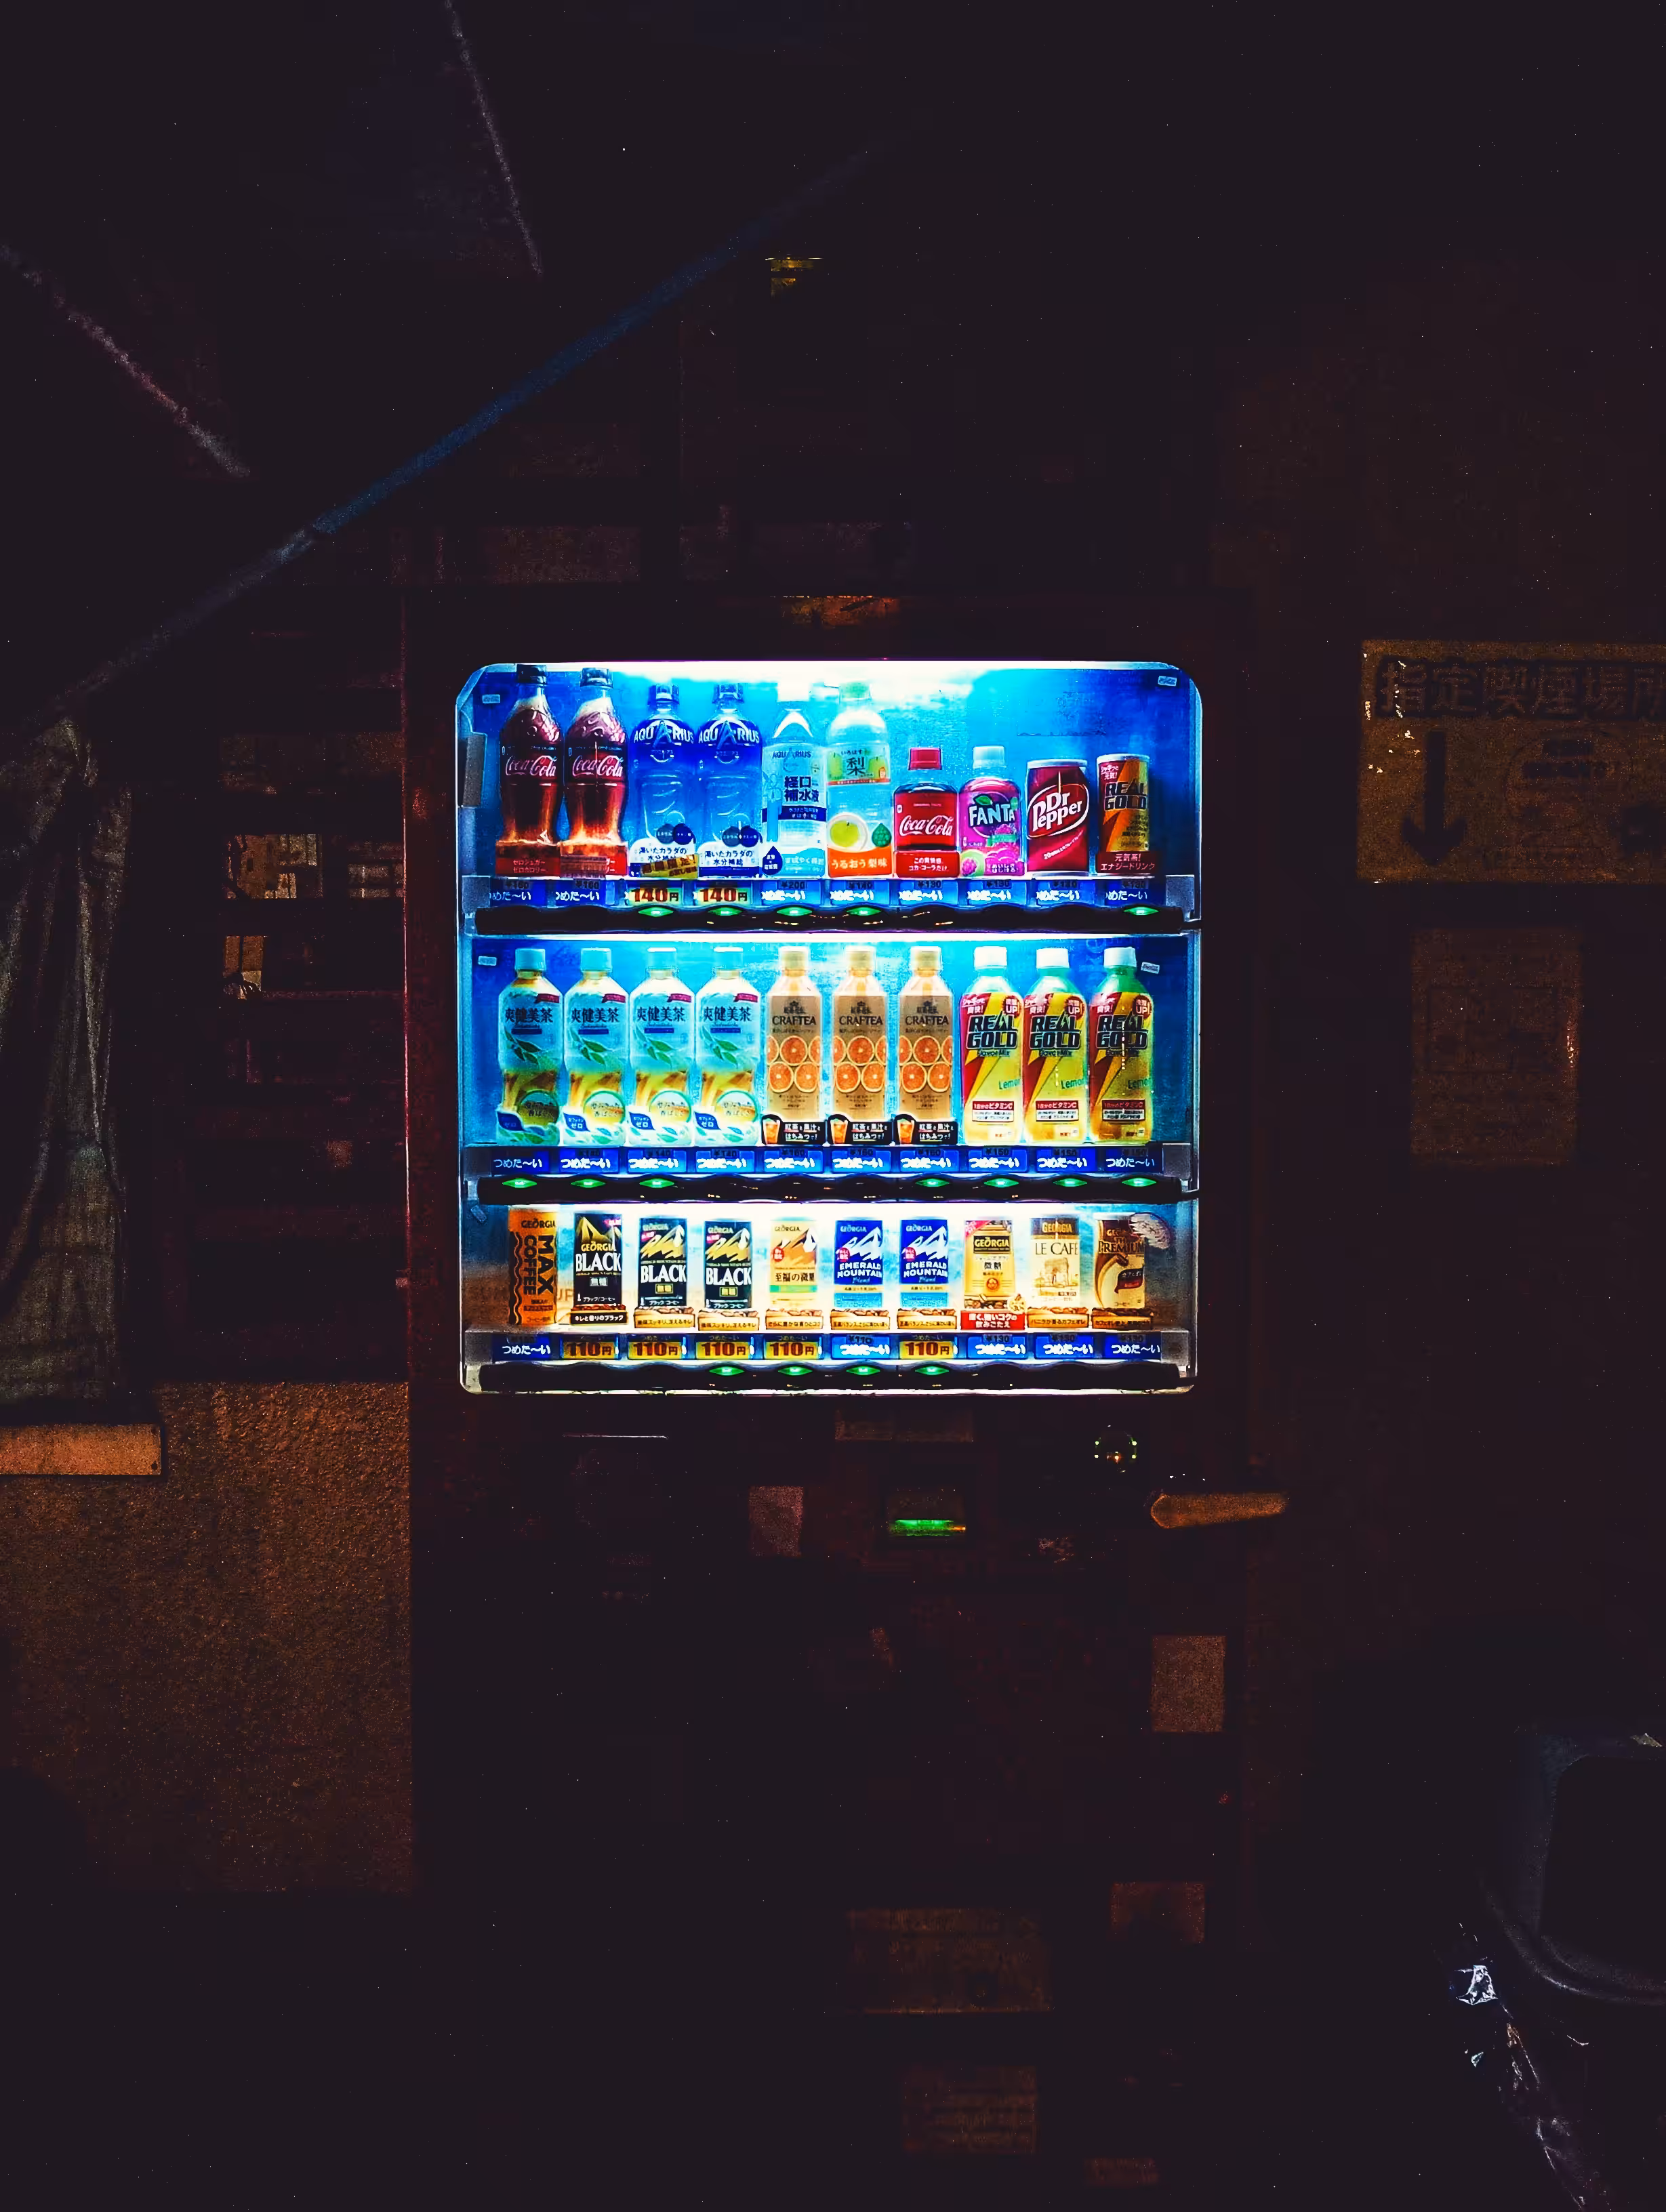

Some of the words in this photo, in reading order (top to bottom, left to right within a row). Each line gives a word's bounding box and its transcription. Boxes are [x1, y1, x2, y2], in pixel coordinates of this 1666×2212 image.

[634, 722, 694, 747] AQUARIUS
[698, 722, 760, 748] AQUARIUS
[506, 756, 557, 777] Coca-Cola
[573, 756, 624, 777] Coca-Cola
[847, 756, 867, 776] 梨
[784, 776, 811, 788] 経口
[1105, 782, 1147, 797] REAL
[1047, 792, 1070, 810] Dr
[1104, 796, 1147, 811] GOLD
[969, 804, 1015, 827] FANTA
[1032, 800, 1082, 832] Pepper
[899, 815, 954, 836] Coca-Cola
[631, 888, 679, 902] 140円
[699, 888, 748, 902] 140円
[505, 1007, 553, 1023] 爽健美茶
[571, 1007, 619, 1023] 爽健美茶
[637, 1006, 686, 1022] 爽健美茶
[704, 1006, 752, 1022] 爽健美茶
[772, 1016, 817, 1025] CRAFTEA
[839, 1016, 884, 1025] CRAFTEA
[905, 1016, 950, 1025] CRAFTEA
[969, 1014, 1019, 1032] REAL
[1031, 1014, 1081, 1032] REAL
[1097, 1014, 1148, 1032] REAL
[966, 1031, 1018, 1050] GOLD
[1029, 1031, 1081, 1050] GOLD
[1095, 1031, 1147, 1050] GOLD
[974, 1237, 1011, 1248] GEORGIA
[1035, 1242, 1047, 1255] LE
[523, 1235, 537, 1296] COFFEE
[537, 1235, 554, 1296] MAX
[575, 1252, 622, 1272] BLACK
[839, 1262, 882, 1271] EMERALD
[906, 1261, 948, 1270] EMERALD
[641, 1265, 687, 1283] BLACK
[706, 1267, 752, 1286] BLACK
[567, 1343, 612, 1357] 110円
[633, 1342, 678, 1357] 110円
[702, 1343, 746, 1357] 110円
[770, 1342, 815, 1357] 110円
[905, 1342, 950, 1356] 110円
